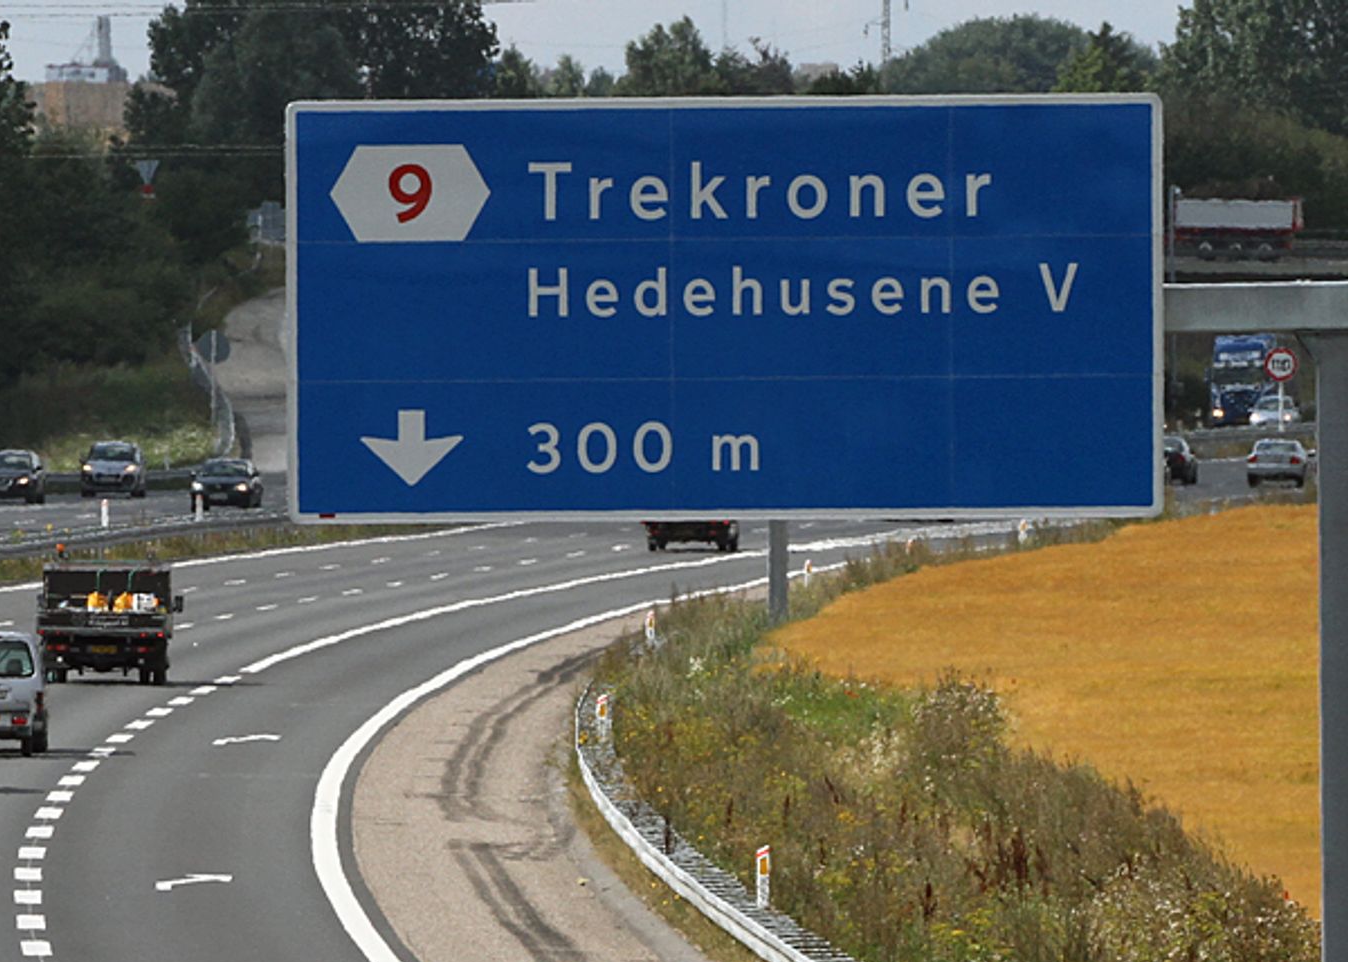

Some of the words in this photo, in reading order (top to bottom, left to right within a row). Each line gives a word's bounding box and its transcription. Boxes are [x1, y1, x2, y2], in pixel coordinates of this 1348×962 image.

[389, 165, 432, 222] 9
[528, 161, 991, 220] Trekroner
[528, 266, 999, 317] Hedehusene
[1039, 262, 1078, 312] V
[527, 422, 673, 473] 300
[712, 435, 759, 471] m
